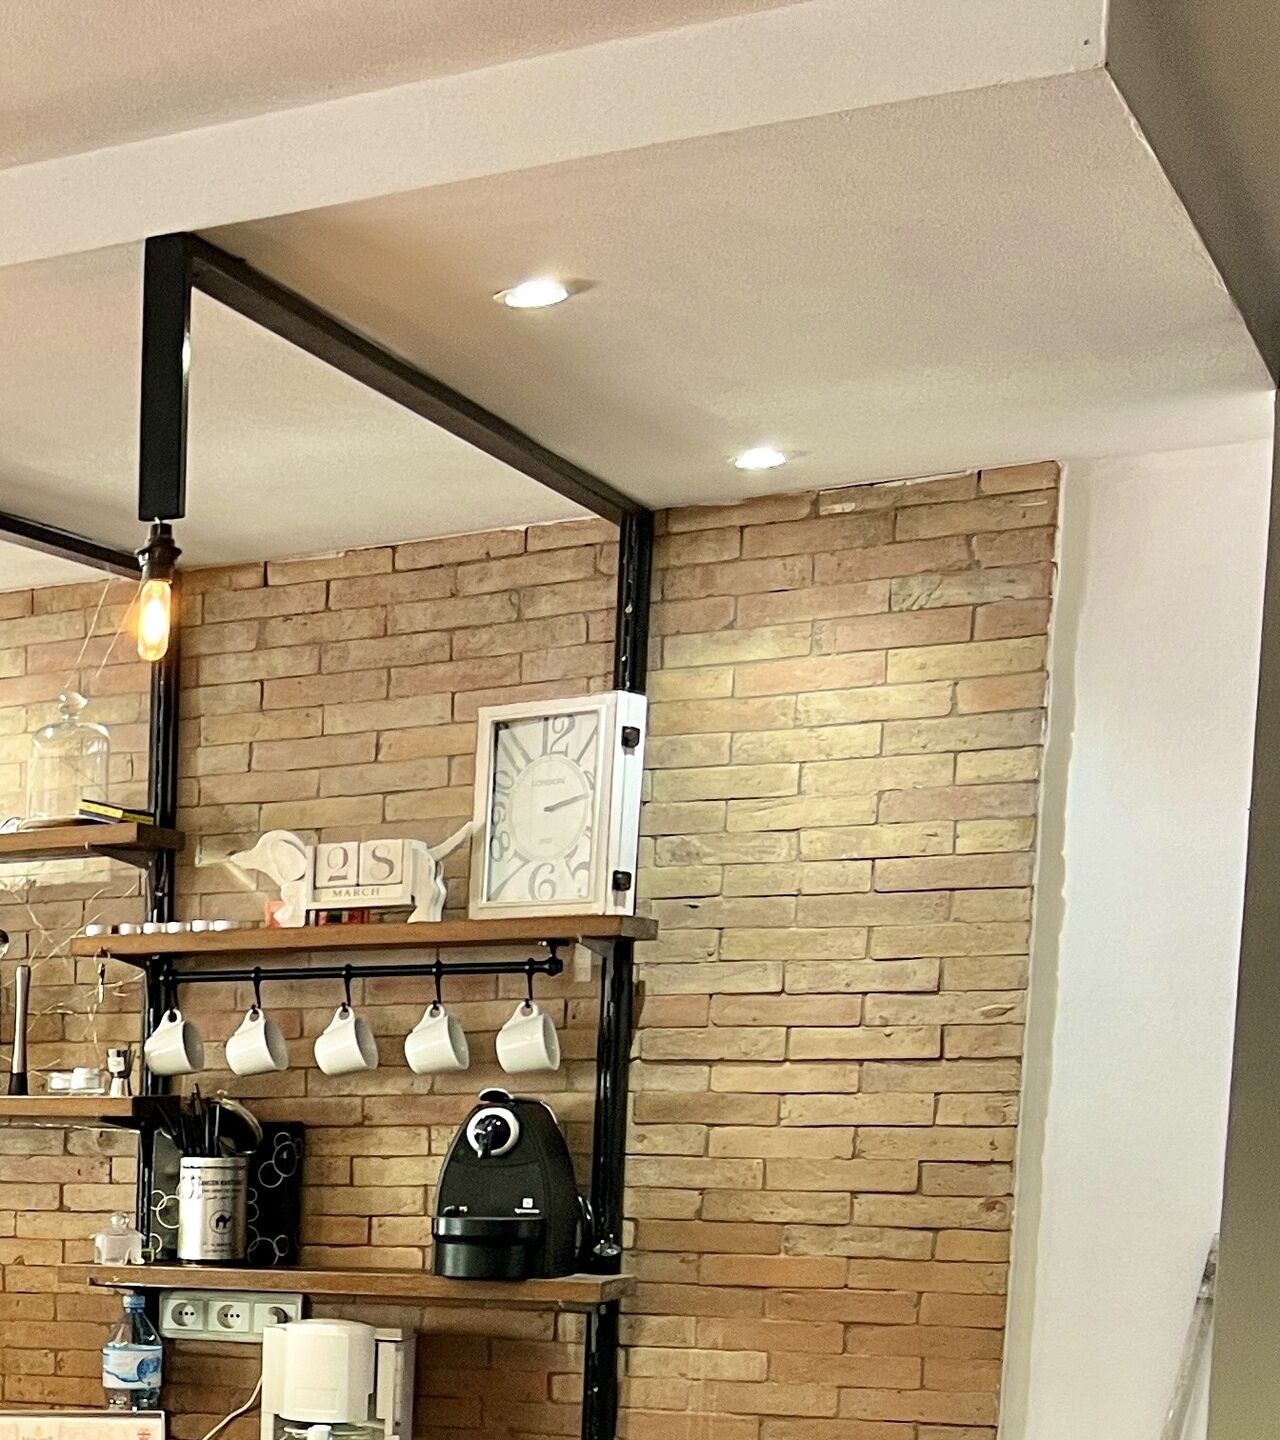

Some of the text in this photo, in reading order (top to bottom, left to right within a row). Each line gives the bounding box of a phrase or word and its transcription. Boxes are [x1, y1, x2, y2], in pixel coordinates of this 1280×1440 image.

[540, 714, 576, 757] 12
[331, 887, 381, 898] MARCH
[528, 862, 557, 901] 6
